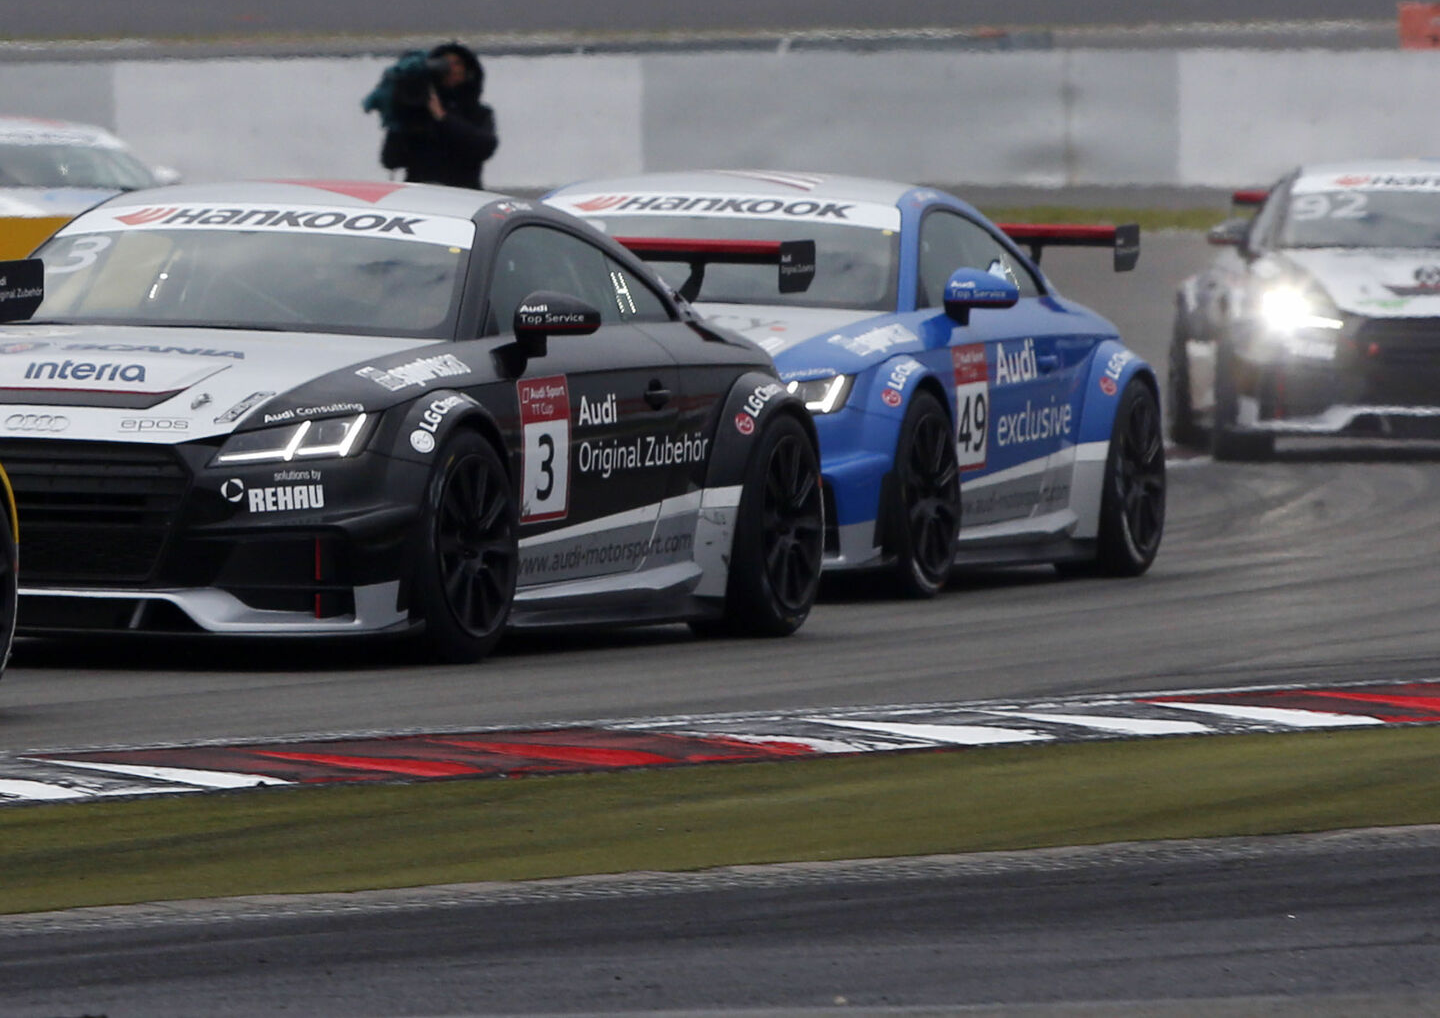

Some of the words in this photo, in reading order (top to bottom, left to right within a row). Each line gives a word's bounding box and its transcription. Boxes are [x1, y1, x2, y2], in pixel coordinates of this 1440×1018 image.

[47, 235, 112, 274] 3
[520, 304, 548, 312] Audi
[520, 314, 543, 324] Top
[545, 313, 584, 323] Service
[997, 338, 1037, 385] Audi
[264, 412, 295, 423] Audi
[296, 401, 364, 417] Consulting
[579, 393, 617, 426] Audi
[743, 395, 764, 418] LG
[120, 419, 189, 431] epos
[419, 410, 442, 433] LG
[960, 393, 987, 453] 49
[997, 404, 1072, 447] exclusive
[536, 433, 555, 502] 3
[579, 440, 641, 478] Original
[645, 433, 709, 466] Zubehör
[274, 471, 310, 481] solutions
[248, 485, 325, 513] REHAU
